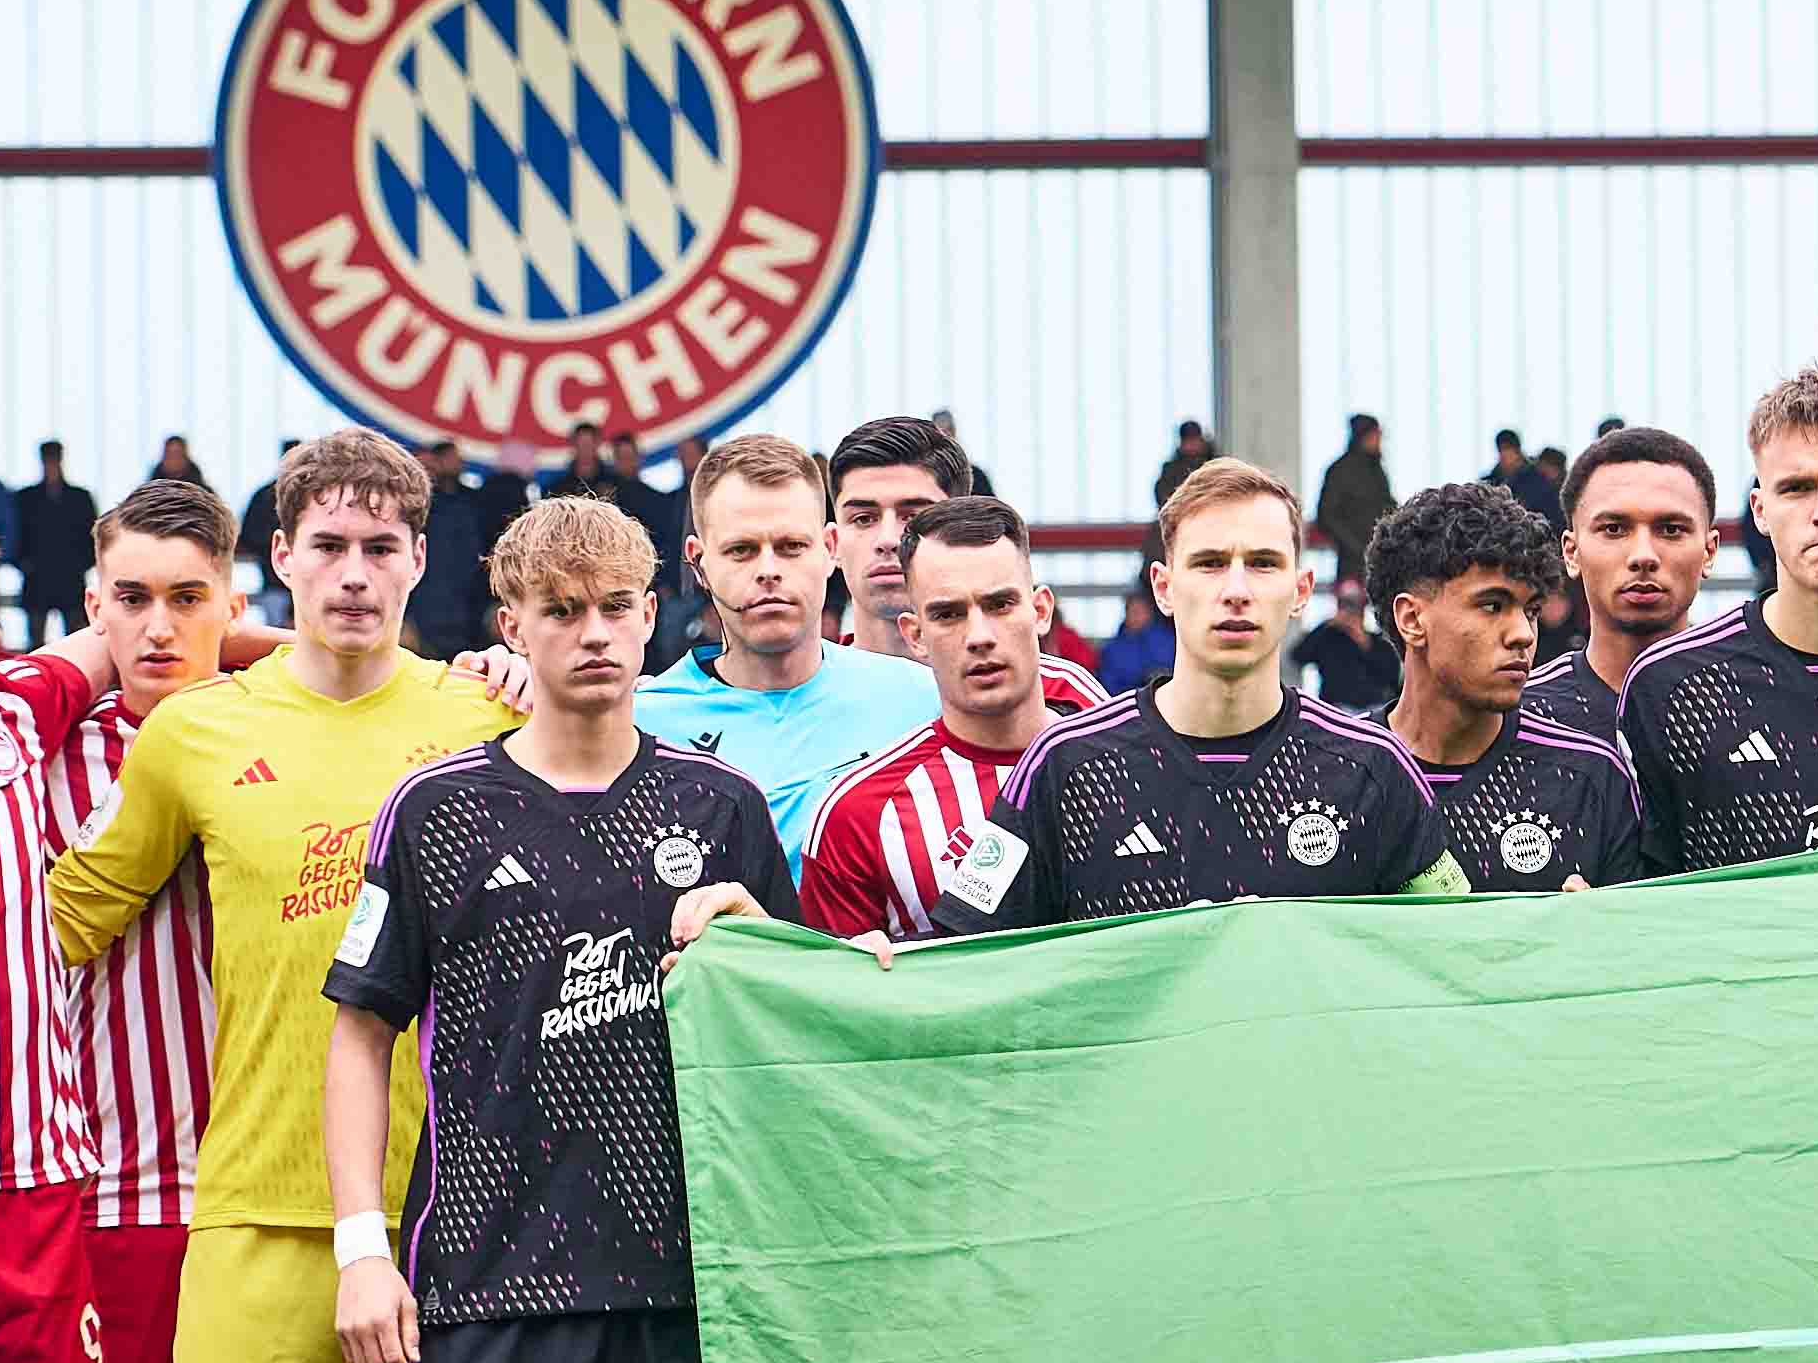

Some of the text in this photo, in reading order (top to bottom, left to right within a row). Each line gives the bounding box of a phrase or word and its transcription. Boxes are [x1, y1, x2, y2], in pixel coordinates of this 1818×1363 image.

[279, 207, 825, 435] MÜNCHEN
[301, 820, 373, 862] ROT
[1304, 819, 1333, 837] BAYERN
[299, 840, 365, 888] GEGEN
[281, 875, 365, 923] RASSIS
[560, 947, 626, 1002] GEGEN
[561, 928, 635, 977] ROT
[540, 966, 664, 1041] RASSISMUS
